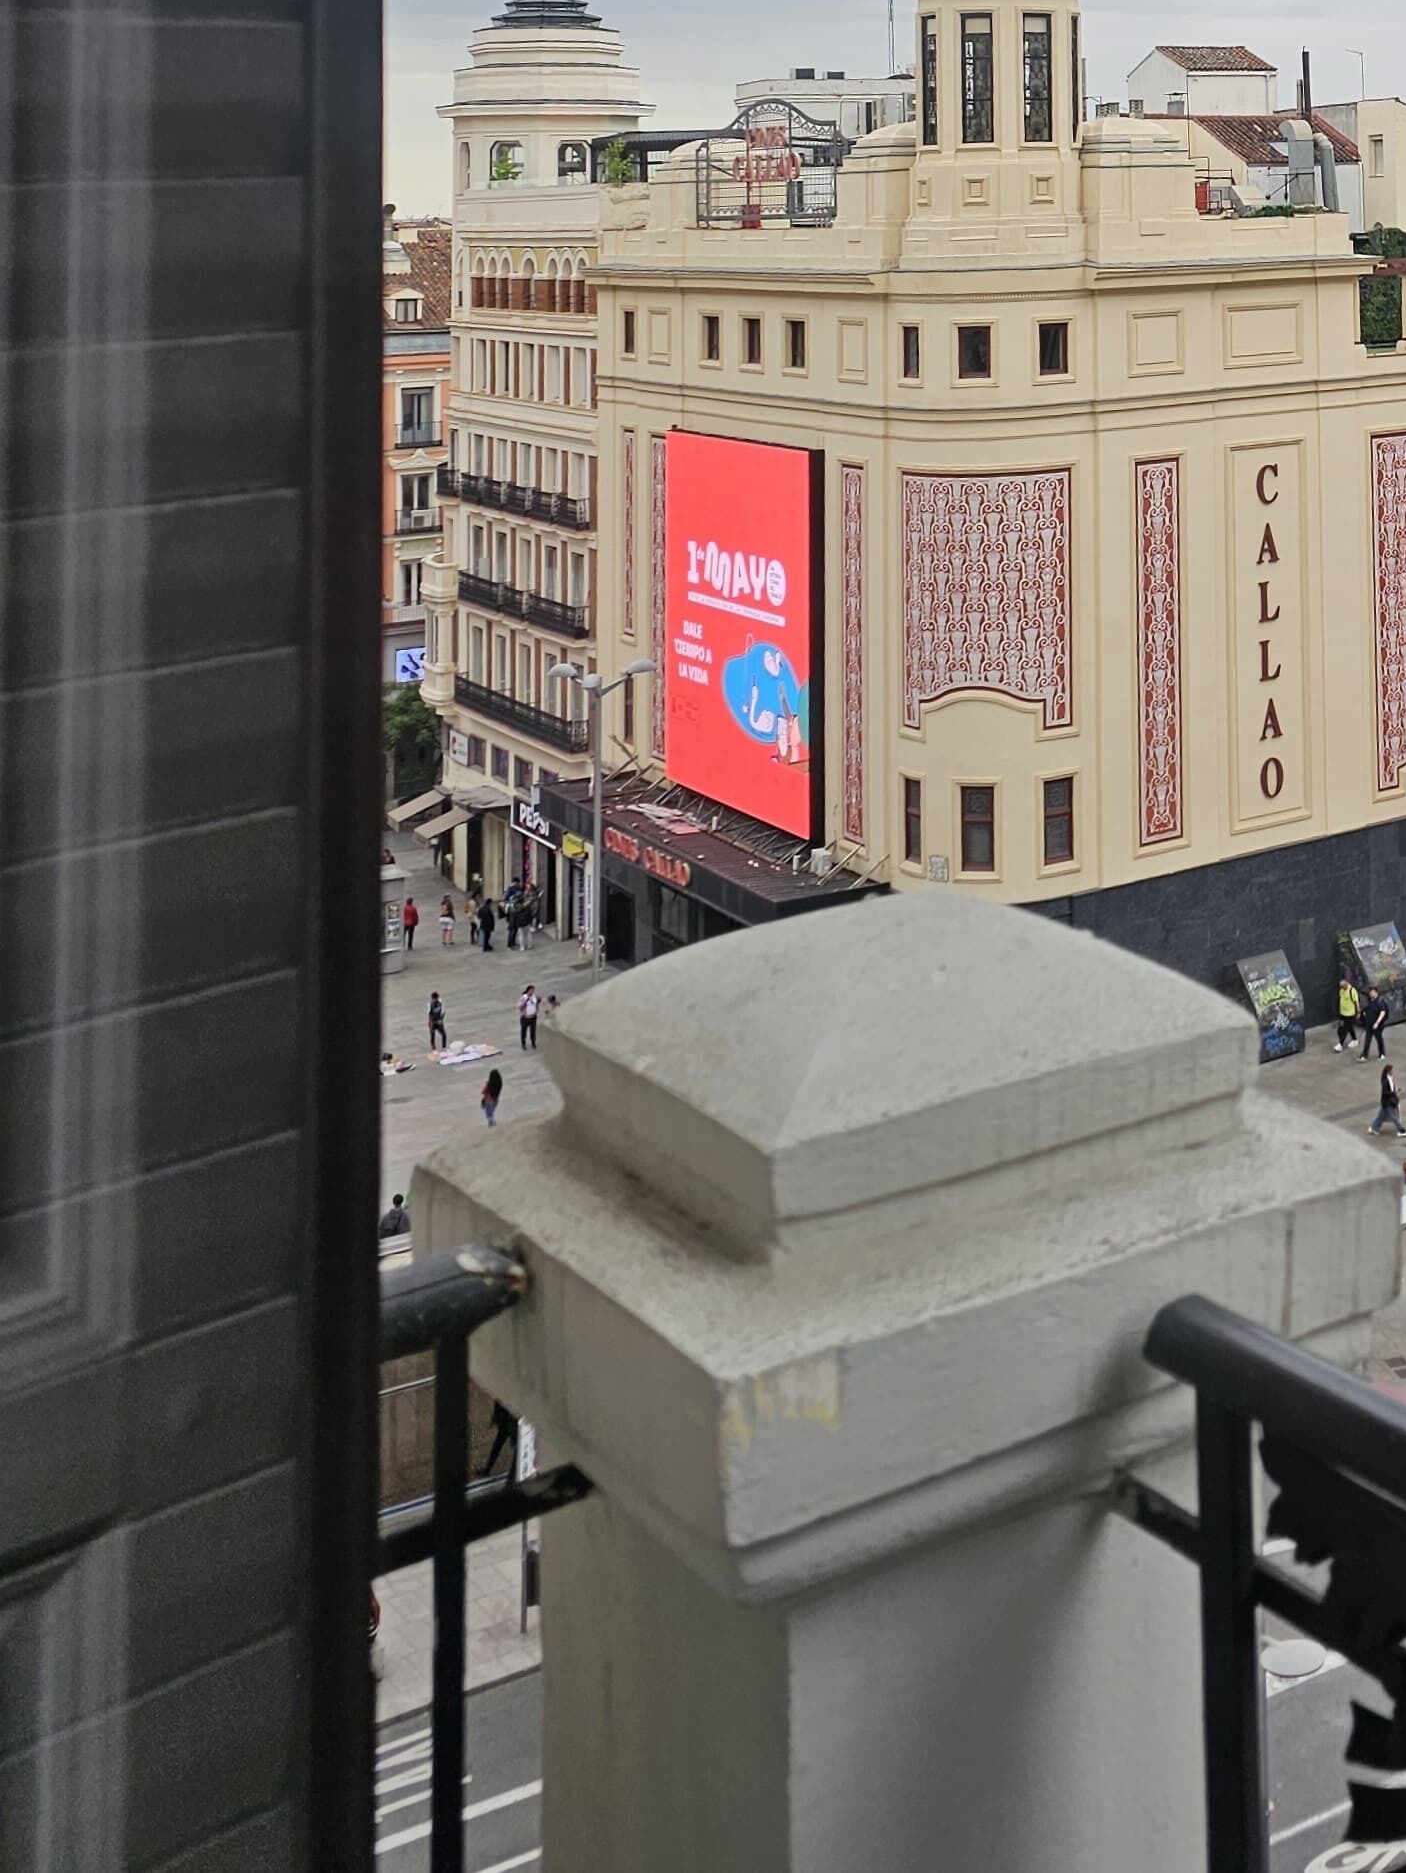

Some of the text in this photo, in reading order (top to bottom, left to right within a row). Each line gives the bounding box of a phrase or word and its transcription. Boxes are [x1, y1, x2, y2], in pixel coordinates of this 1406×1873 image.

[703, 541, 787, 607] MAYO
[683, 620, 703, 639] DALE
[1256, 462, 1285, 800] CALLAO
[678, 662, 709, 686] LA VIDA
[704, 648, 713, 665] A
[519, 802, 550, 837] PEPSI
[643, 846, 692, 887] CALLAO
